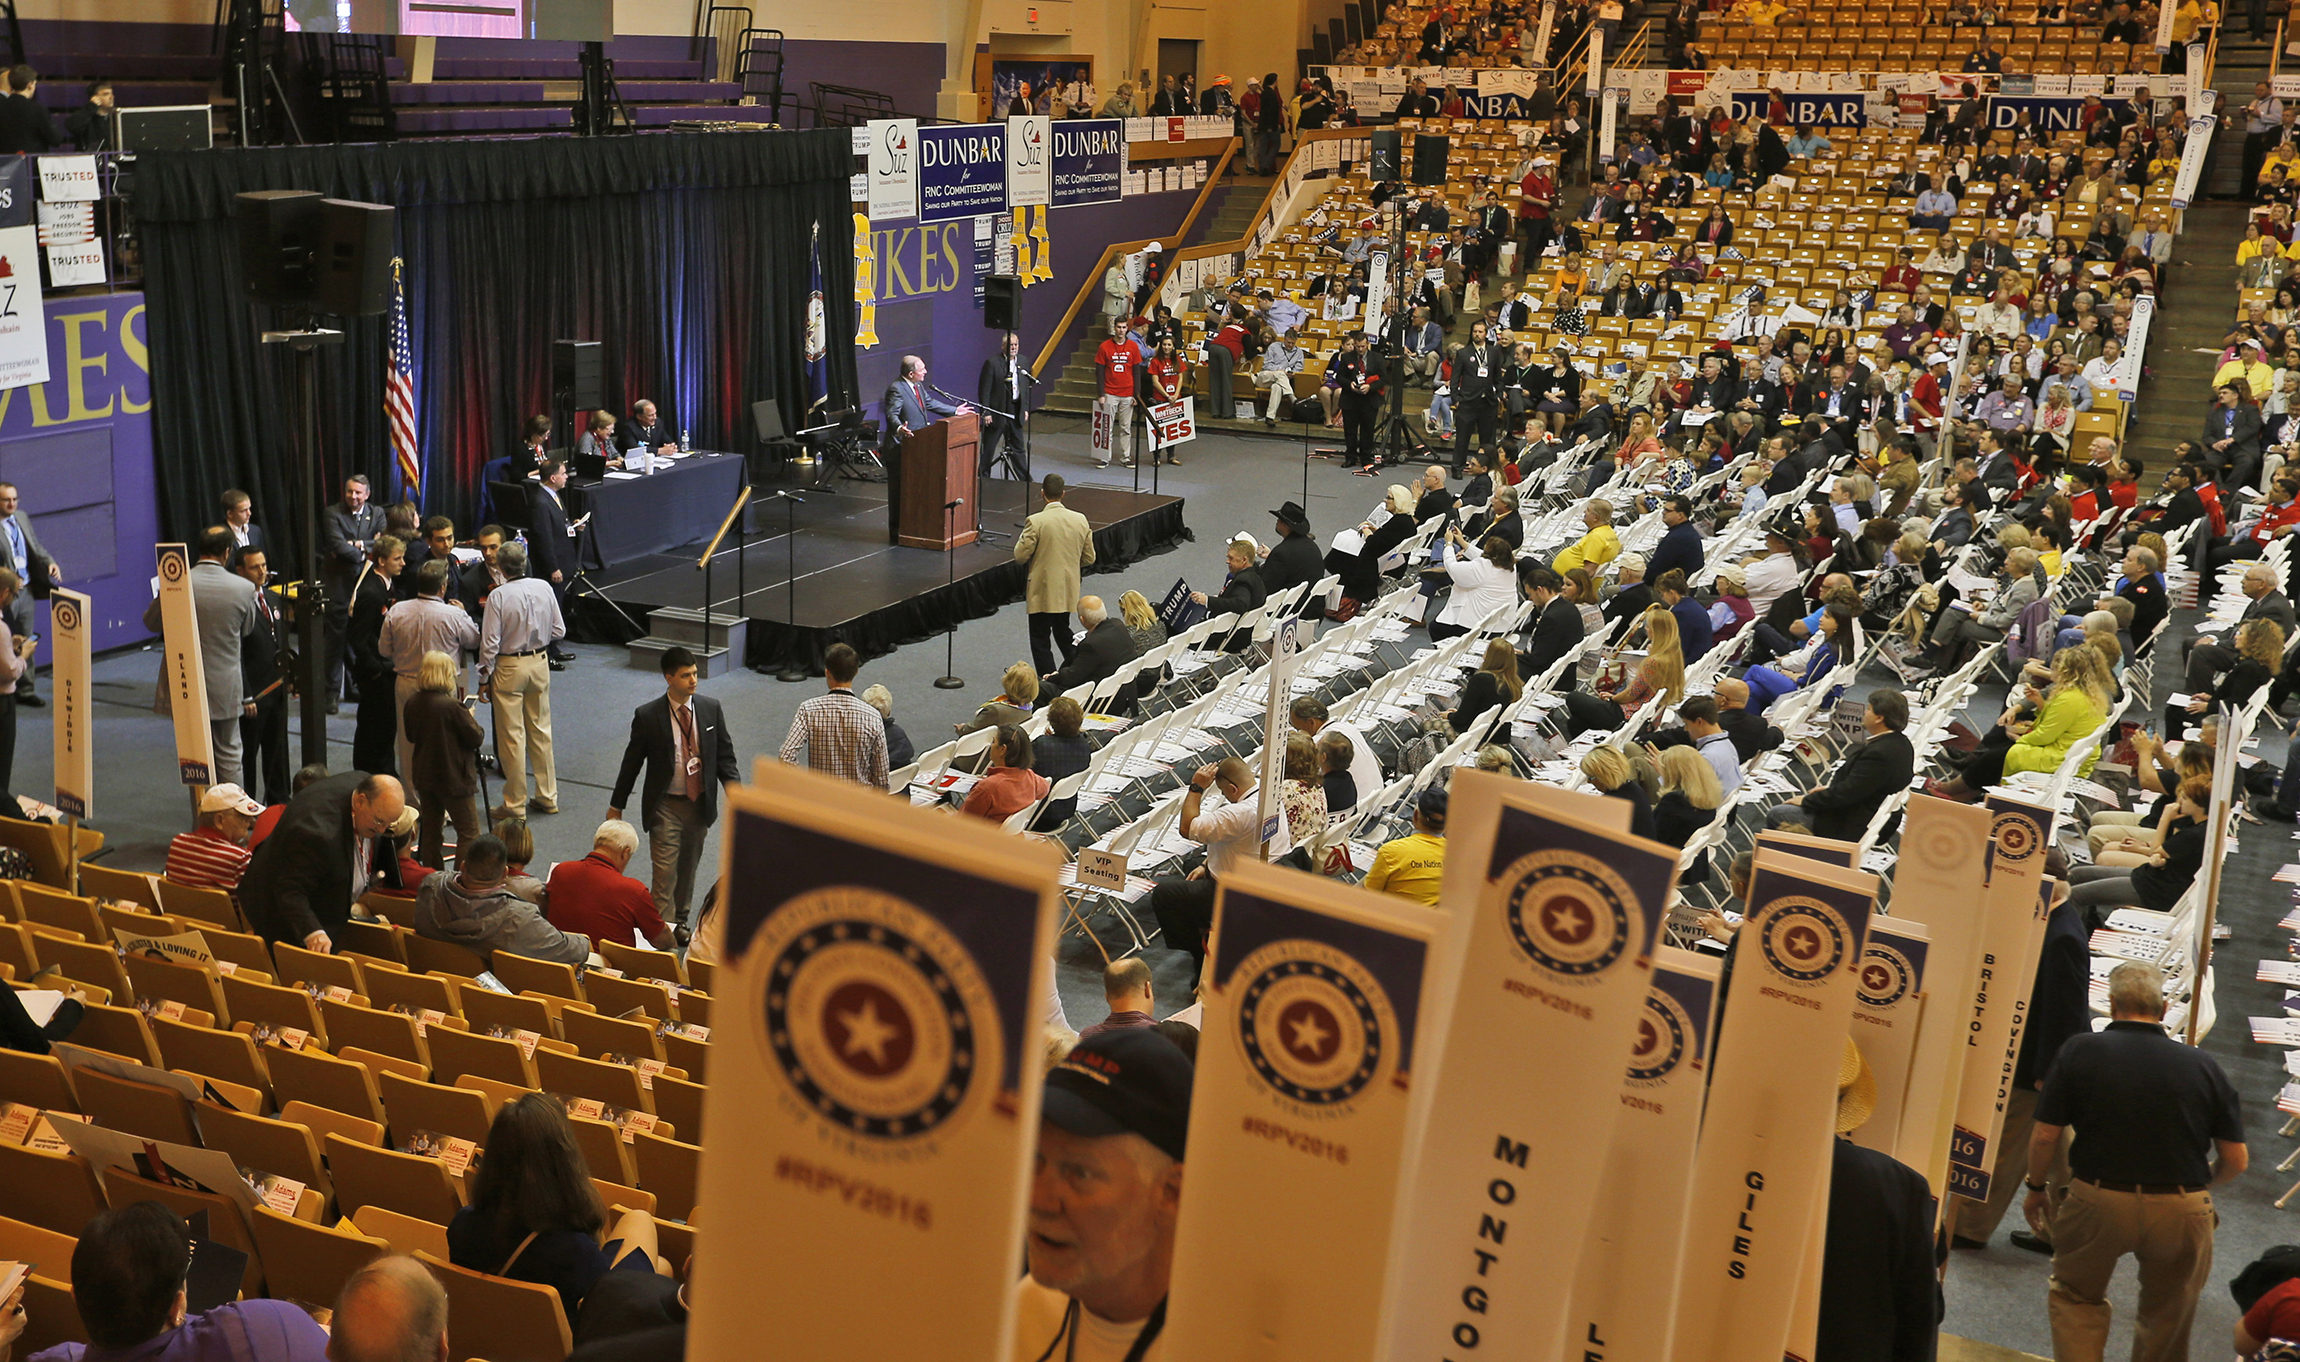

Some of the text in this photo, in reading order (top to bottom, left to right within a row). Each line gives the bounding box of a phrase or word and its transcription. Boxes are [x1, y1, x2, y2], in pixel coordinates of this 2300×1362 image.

[922, 135, 1003, 167] DUNBAR
[1054, 130, 1119, 158] DUNBAR
[1084, 159, 1093, 173] for
[43, 171, 94, 182] TRUSTED
[960, 168, 971, 184] for
[1055, 174, 1070, 186] RNC
[851, 188, 867, 196] RUMP
[925, 185, 943, 198] RNC
[53, 201, 80, 210] CRUZ
[997, 222, 1013, 233] CRUZ
[51, 254, 101, 266] TRUSTED
[974, 262, 991, 270] TRUMP
[1155, 404, 1183, 417] WHITBECK
[1093, 411, 1102, 448] NO
[1151, 419, 1192, 445] YES
[1162, 583, 1187, 620] TRUMP
[178, 653, 189, 700] BLAND
[1277, 678, 1287, 739] BEDFORD
[1840, 713, 1861, 722] WITH
[185, 767, 206, 779] 2016
[1272, 748, 1281, 800] COUNTY
[60, 798, 82, 812] 2016
[1264, 821, 1278, 835] 2016
[1095, 856, 1112, 867] VIP
[1410, 860, 1443, 868] One Nation
[1993, 863, 2026, 877] RPV2016
[1084, 865, 1120, 882] Seating
[1763, 895, 1850, 935] REPUBLICAN PARTY
[1681, 924, 1708, 937] WIT
[162, 942, 198, 959] LOVING
[198, 952, 209, 962] IT
[1778, 973, 1829, 990] VIRGINIA
[1503, 977, 1595, 1021] #RPV2016
[1759, 985, 1822, 1010] #RPV2016
[1968, 953, 1995, 1047] BRISTOL
[1852, 1011, 1893, 1028] RPV2016
[1070, 1049, 1121, 1075] UMP
[1995, 1000, 2026, 1113] COVINGTON
[642, 1063, 660, 1073] Adams
[577, 1103, 598, 1116] Adams
[1620, 1093, 1664, 1115] V2016
[9, 1108, 30, 1125] Adams
[631, 1115, 651, 1129] Adams
[447, 1142, 468, 1156] Adams
[1241, 1115, 1349, 1167] #RPV2016
[1954, 1136, 1975, 1156] 16
[1950, 1168, 1980, 1190] 016
[273, 1183, 297, 1196] Adams
[1727, 1171, 1765, 1280] GILES
[1446, 1134, 1531, 1361] MONTGO
